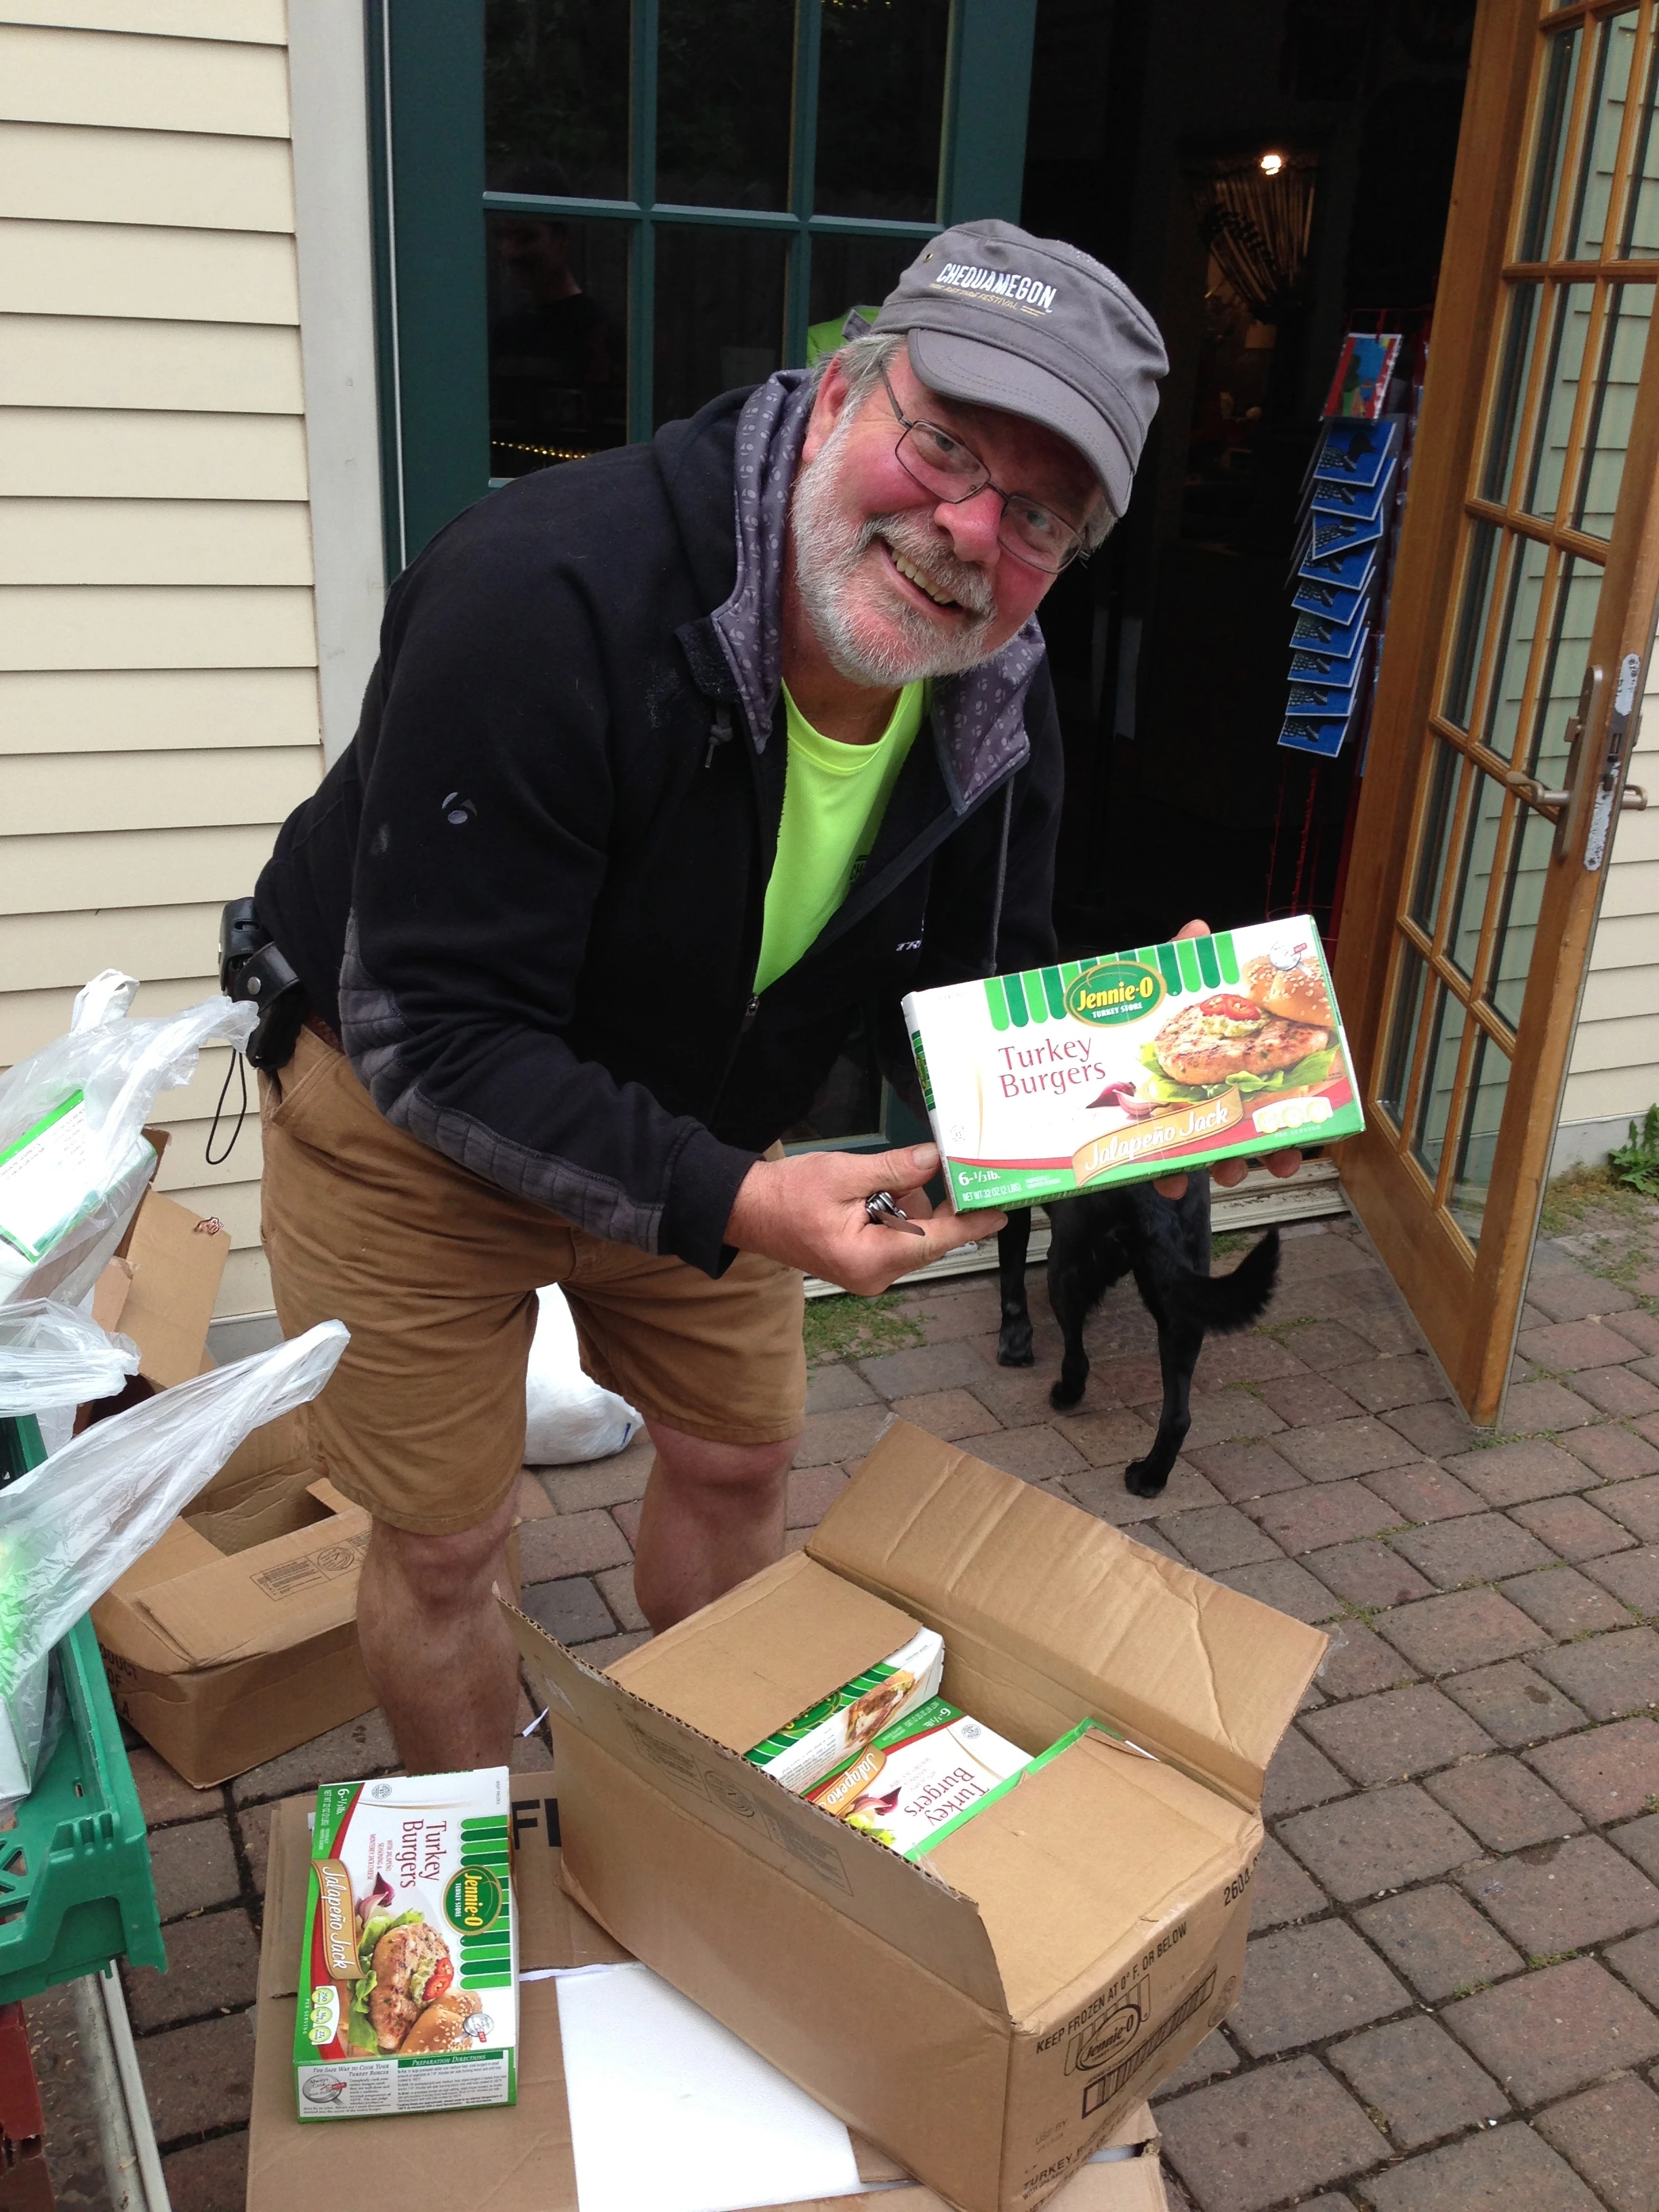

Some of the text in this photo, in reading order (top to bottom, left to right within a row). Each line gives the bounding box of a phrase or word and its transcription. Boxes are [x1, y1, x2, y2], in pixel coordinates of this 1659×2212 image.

[936, 263, 1057, 310] CHEQUAMEGON
[978, 293, 1018, 310] FESTIVAL
[1092, 1002, 1143, 1019] TURKEY STORE
[998, 1038, 1091, 1070] Turkey
[998, 1062, 1105, 1097] Burgers
[1085, 1100, 1228, 1172] Jalapeño Jack
[904, 1767, 975, 1816] Burgers
[926, 1783, 990, 1826] Turkey
[395, 1819, 424, 1888] Burgers
[418, 1820, 447, 1881] Turkey
[321, 1866, 347, 1930] Jalapeño
[330, 1932, 355, 1969] Jack
[1036, 2027, 1065, 2054] KEEP
[1067, 1994, 1105, 2035] FROZEN
[1107, 1982, 1120, 2003] AT
[1142, 1950, 1155, 1970] OR
[1157, 1922, 1187, 1958] BELOW
[411, 2055, 486, 2066] PREPARATION DIRECTIONS
[1023, 2152, 1073, 2190] TURKEY
